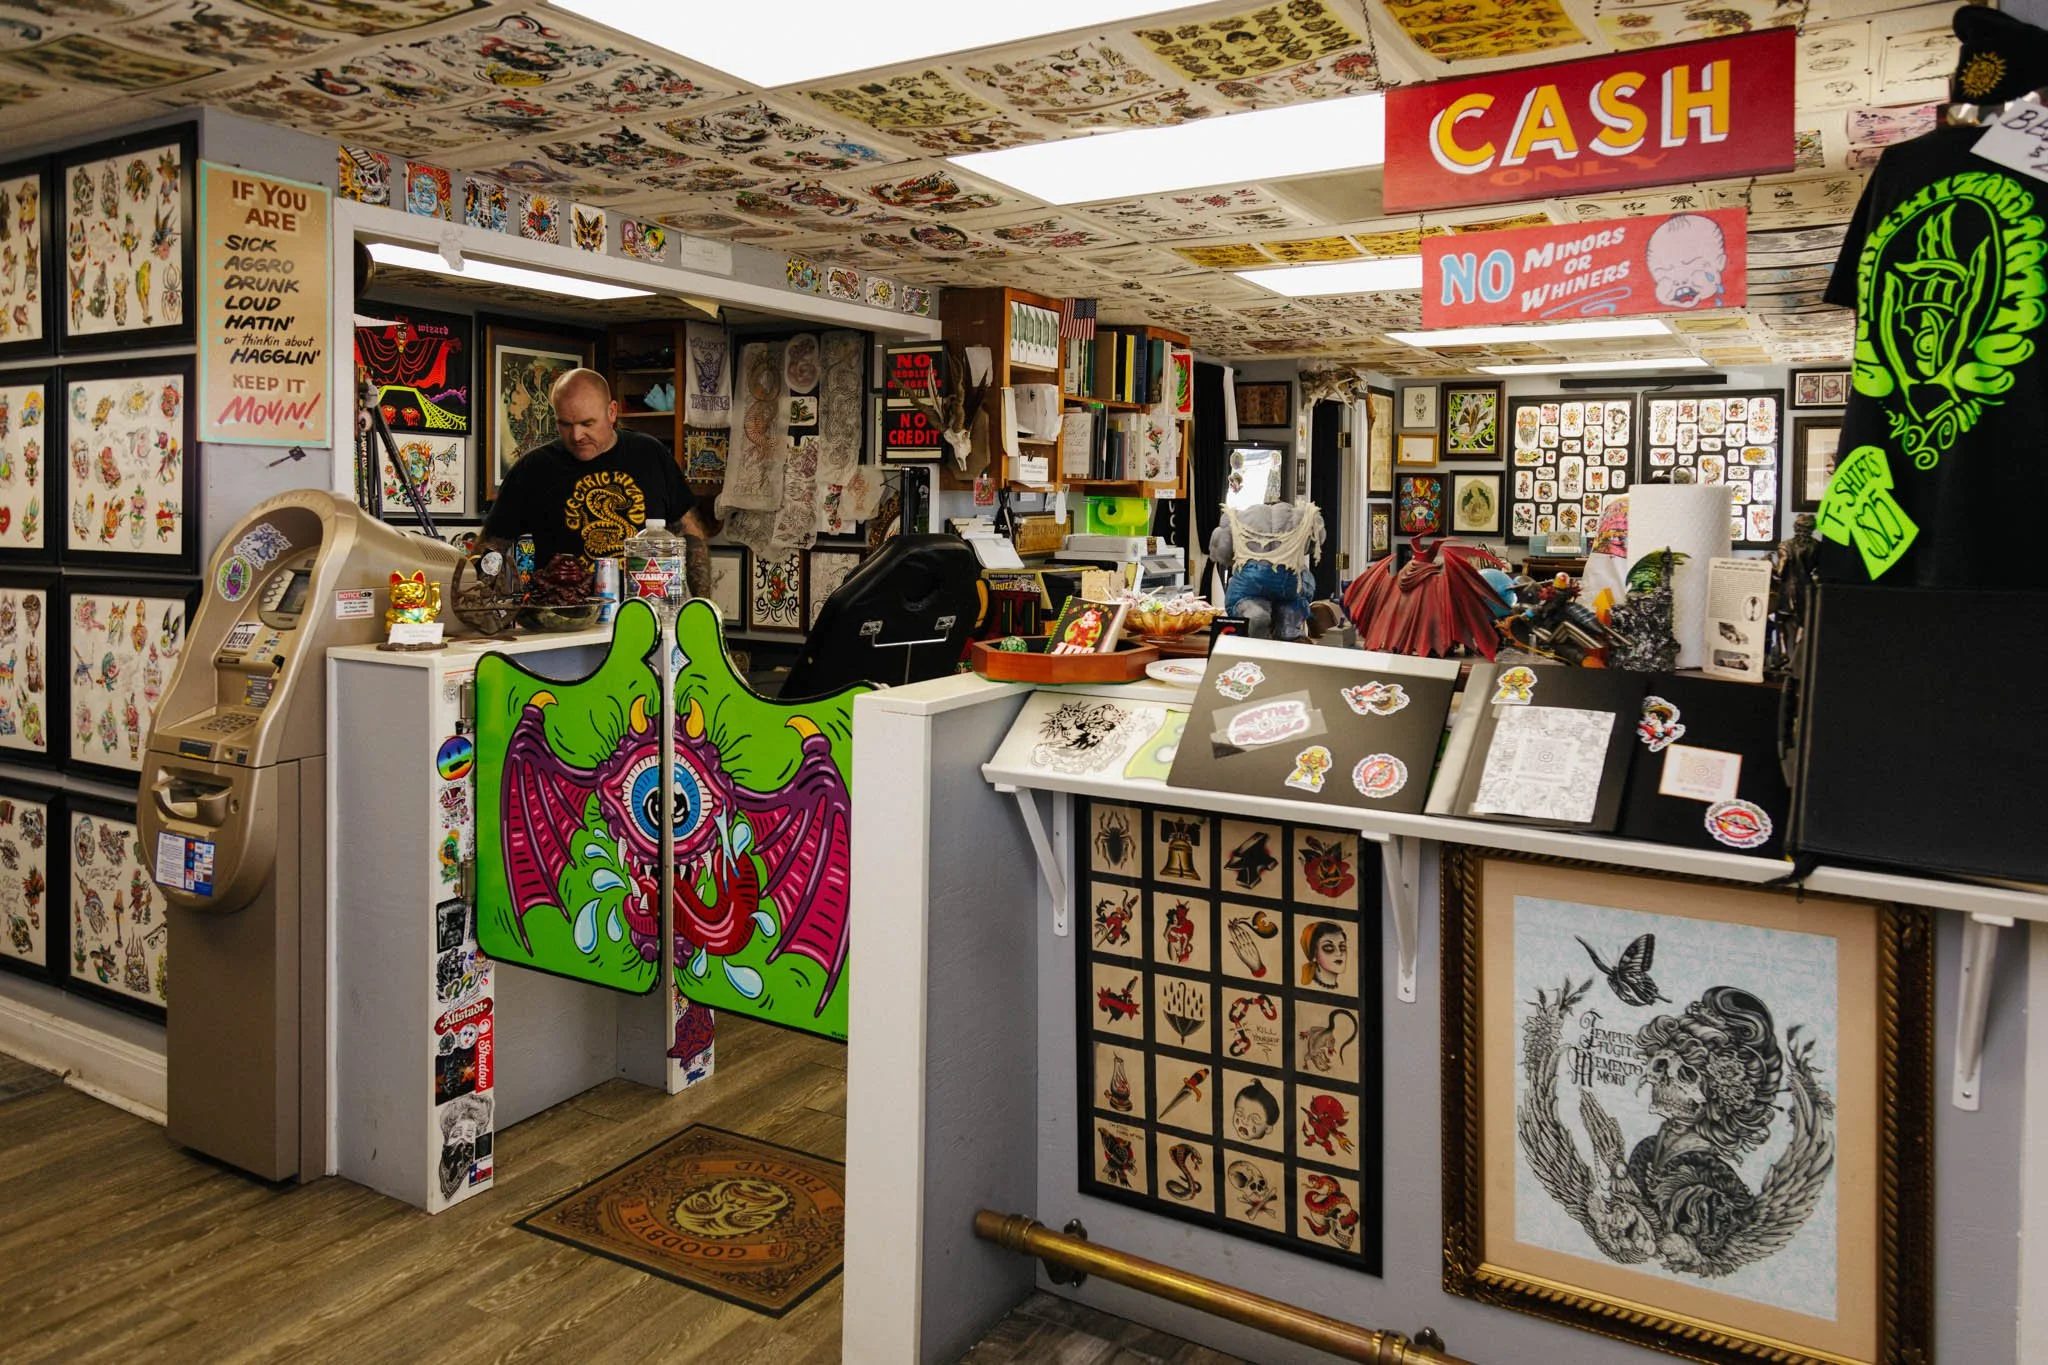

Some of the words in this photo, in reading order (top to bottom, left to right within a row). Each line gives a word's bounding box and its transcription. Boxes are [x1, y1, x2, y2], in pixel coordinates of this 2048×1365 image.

[1429, 59, 1730, 174] CASH
[1490, 152, 1669, 186] ONLY
[232, 180, 254, 200] IF
[260, 182, 307, 212] YOU
[245, 208, 296, 232] ARE
[224, 234, 278, 253] SICK
[1523, 227, 1626, 273] MINORS
[224, 255, 295, 275] AGGRO
[1564, 254, 1593, 275] OR
[224, 274, 300, 294] DRUNK
[1440, 249, 1515, 306] NO
[1521, 260, 1631, 313] WHINERS
[225, 295, 281, 312] LOUD
[224, 314, 295, 332] HATIN'
[224, 336, 237, 345] or
[284, 335, 314, 348] about
[229, 346, 321, 366] HAGGLIN'
[896, 353, 932, 369] NO
[232, 374, 279, 391] KEEP
[287, 378, 306, 394] IT
[216, 392, 321, 430] MOVIN!
[900, 411, 928, 429] NO
[888, 429, 941, 446] CREDIT
[564, 470, 610, 531] ELECTRIC
[612, 470, 647, 525] WIZARD
[442, 1003, 486, 1030] Altstadt
[1579, 1008, 1635, 1049] TEMPUS
[477, 1039, 492, 1089] Shadow
[733, 1160, 828, 1195] FRIEND
[635, 1213, 748, 1259] GOODBYE
